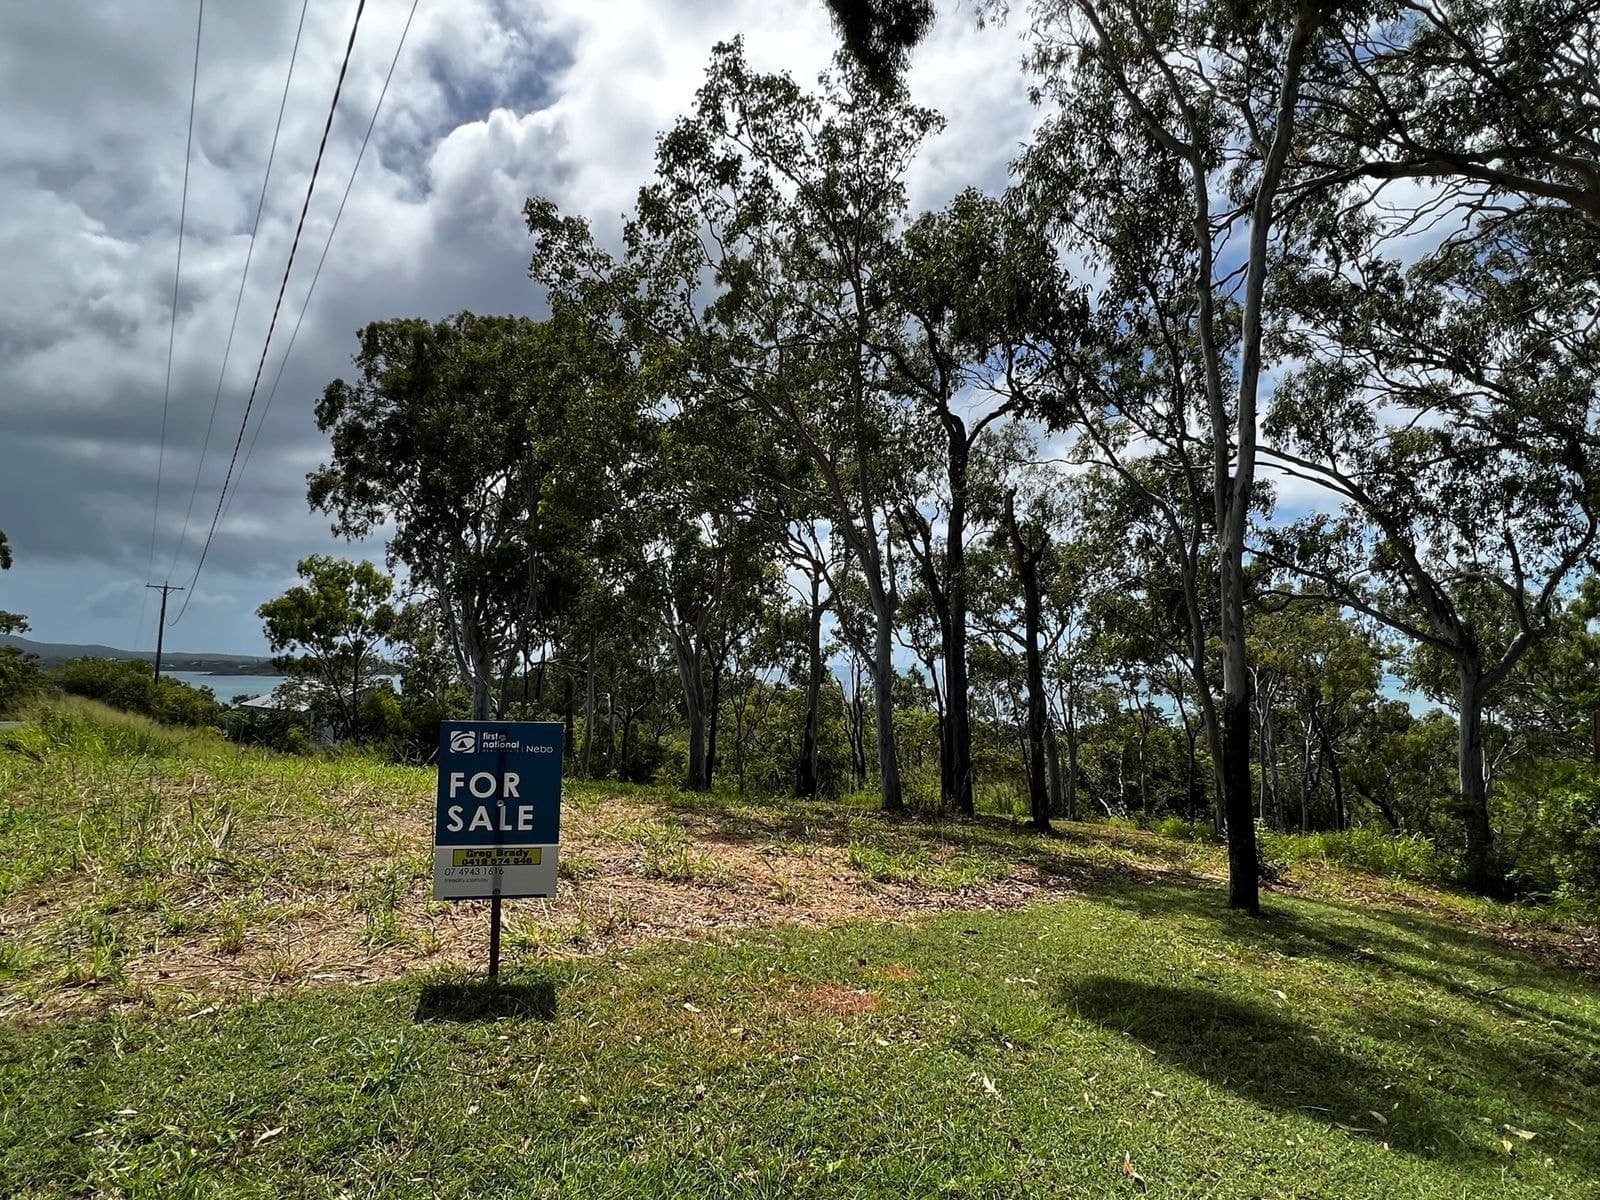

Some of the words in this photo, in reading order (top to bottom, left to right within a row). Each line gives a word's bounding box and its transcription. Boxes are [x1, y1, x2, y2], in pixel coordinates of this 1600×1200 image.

[482, 732, 498, 740] first
[482, 740, 520, 749] national
[526, 745, 554, 754] Nebo
[449, 771, 520, 799] FOR
[446, 804, 534, 832] SALE
[466, 849, 492, 858] Greg
[496, 848, 529, 857] Brady
[444, 868, 456, 876] 07
[459, 867, 480, 876] 4943
[482, 867, 504, 876] 1616
